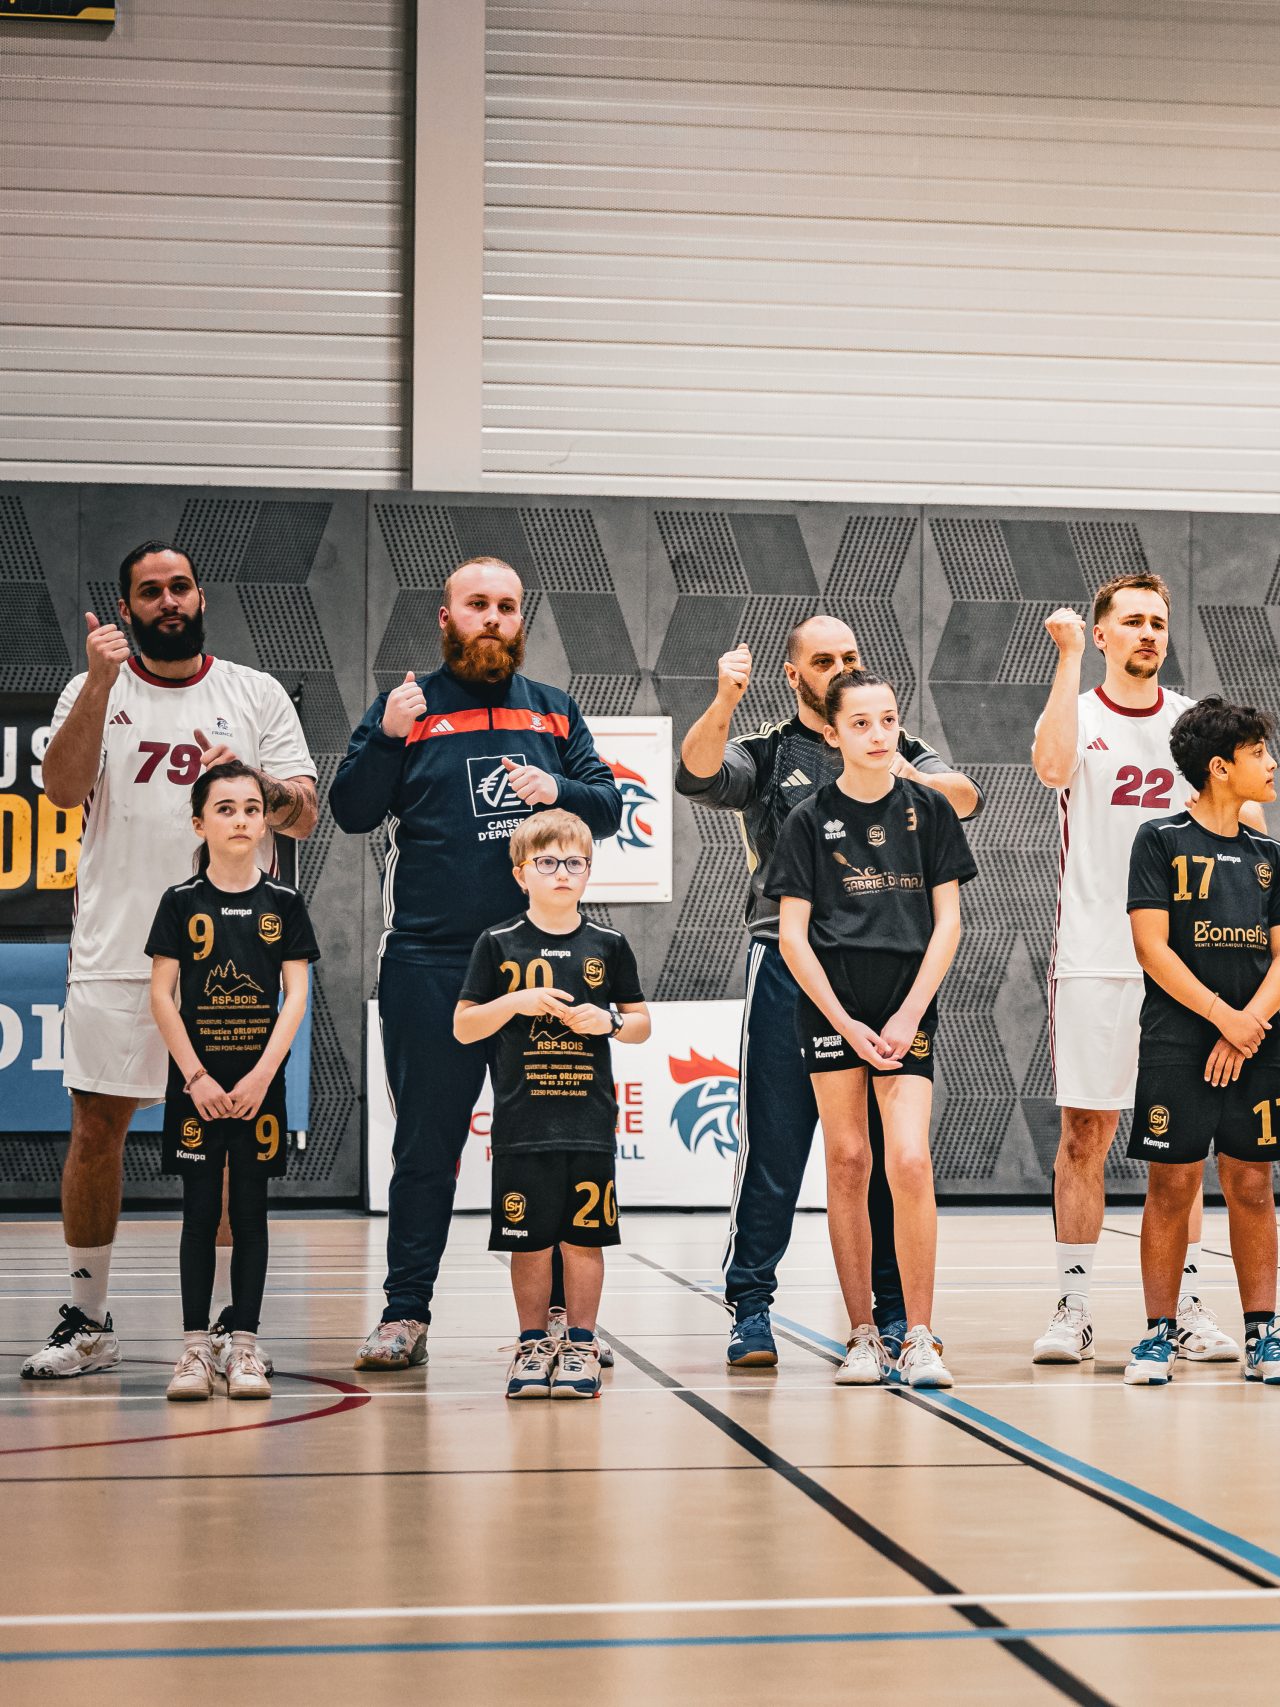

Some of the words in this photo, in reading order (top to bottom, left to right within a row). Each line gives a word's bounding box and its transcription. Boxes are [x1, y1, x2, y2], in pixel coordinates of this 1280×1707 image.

[134, 740, 202, 785] 79
[1110, 765, 1174, 809] 22
[1171, 855, 1215, 901] 17
[221, 908, 252, 917] Kempa
[188, 913, 214, 960] 9
[1194, 921, 1267, 945] Bonnefis
[541, 949, 571, 958] Kempa
[500, 958, 553, 993] 20
[212, 996, 257, 1004] RSP-BOIS
[538, 1041, 583, 1050] RSP-BOIS
[815, 1050, 844, 1059] Kempa
[255, 1114, 279, 1160] 9
[1143, 1136, 1170, 1150] Kempa
[176, 1150, 206, 1162] Kempa
[572, 1179, 617, 1228] 20
[502, 1227, 528, 1238] Kempa
